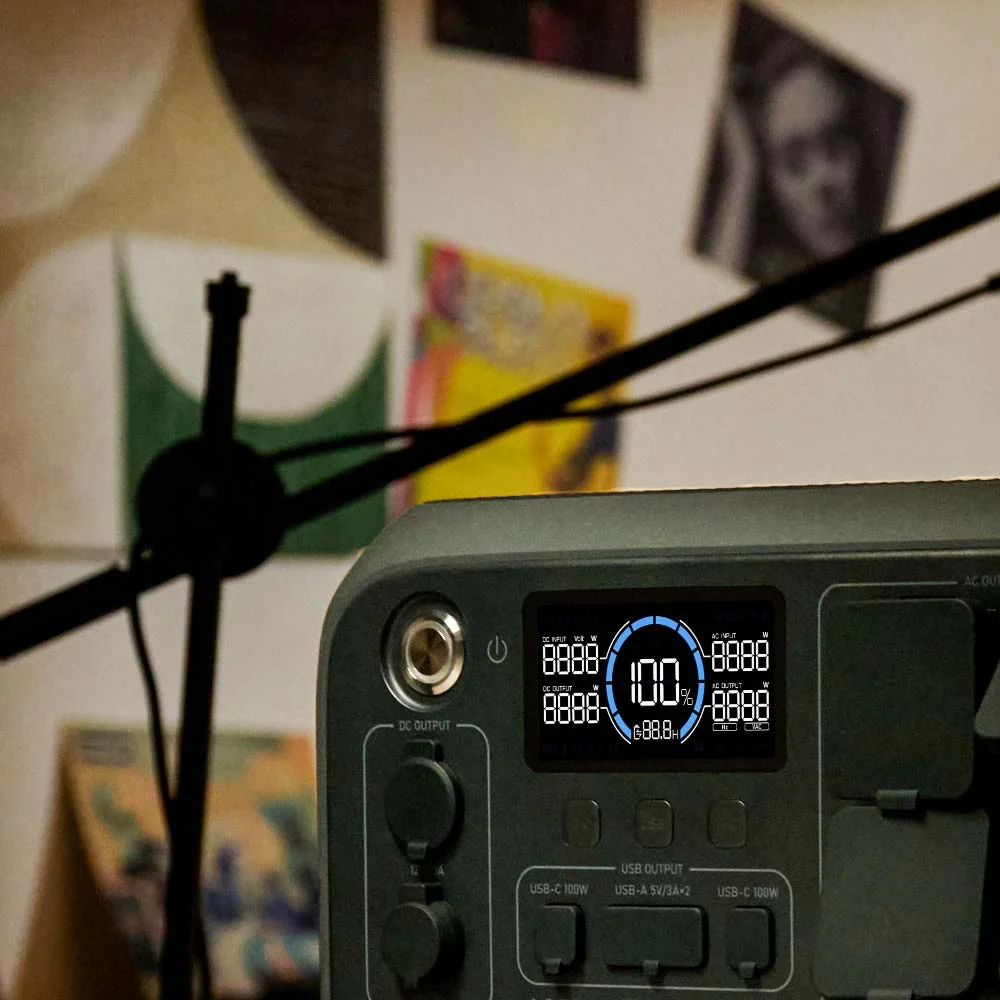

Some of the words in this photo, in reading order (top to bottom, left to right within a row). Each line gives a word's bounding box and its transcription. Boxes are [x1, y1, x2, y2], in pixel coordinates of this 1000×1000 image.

[963, 575, 978, 586] AC
[542, 643, 599, 675] 8888
[711, 640, 769, 672] 8888
[543, 692, 600, 725] 8888
[712, 689, 770, 722] 8888
[399, 720, 412, 731] DC
[414, 720, 451, 732] OUTPUT
[621, 863, 641, 874] USB
[644, 863, 684, 875] OUTPUT
[530, 883, 562, 894] USB-C
[564, 883, 589, 895] 100W
[615, 884, 647, 895] USB-A
[717, 886, 750, 898] USB-C
[753, 887, 779, 898] 100W
